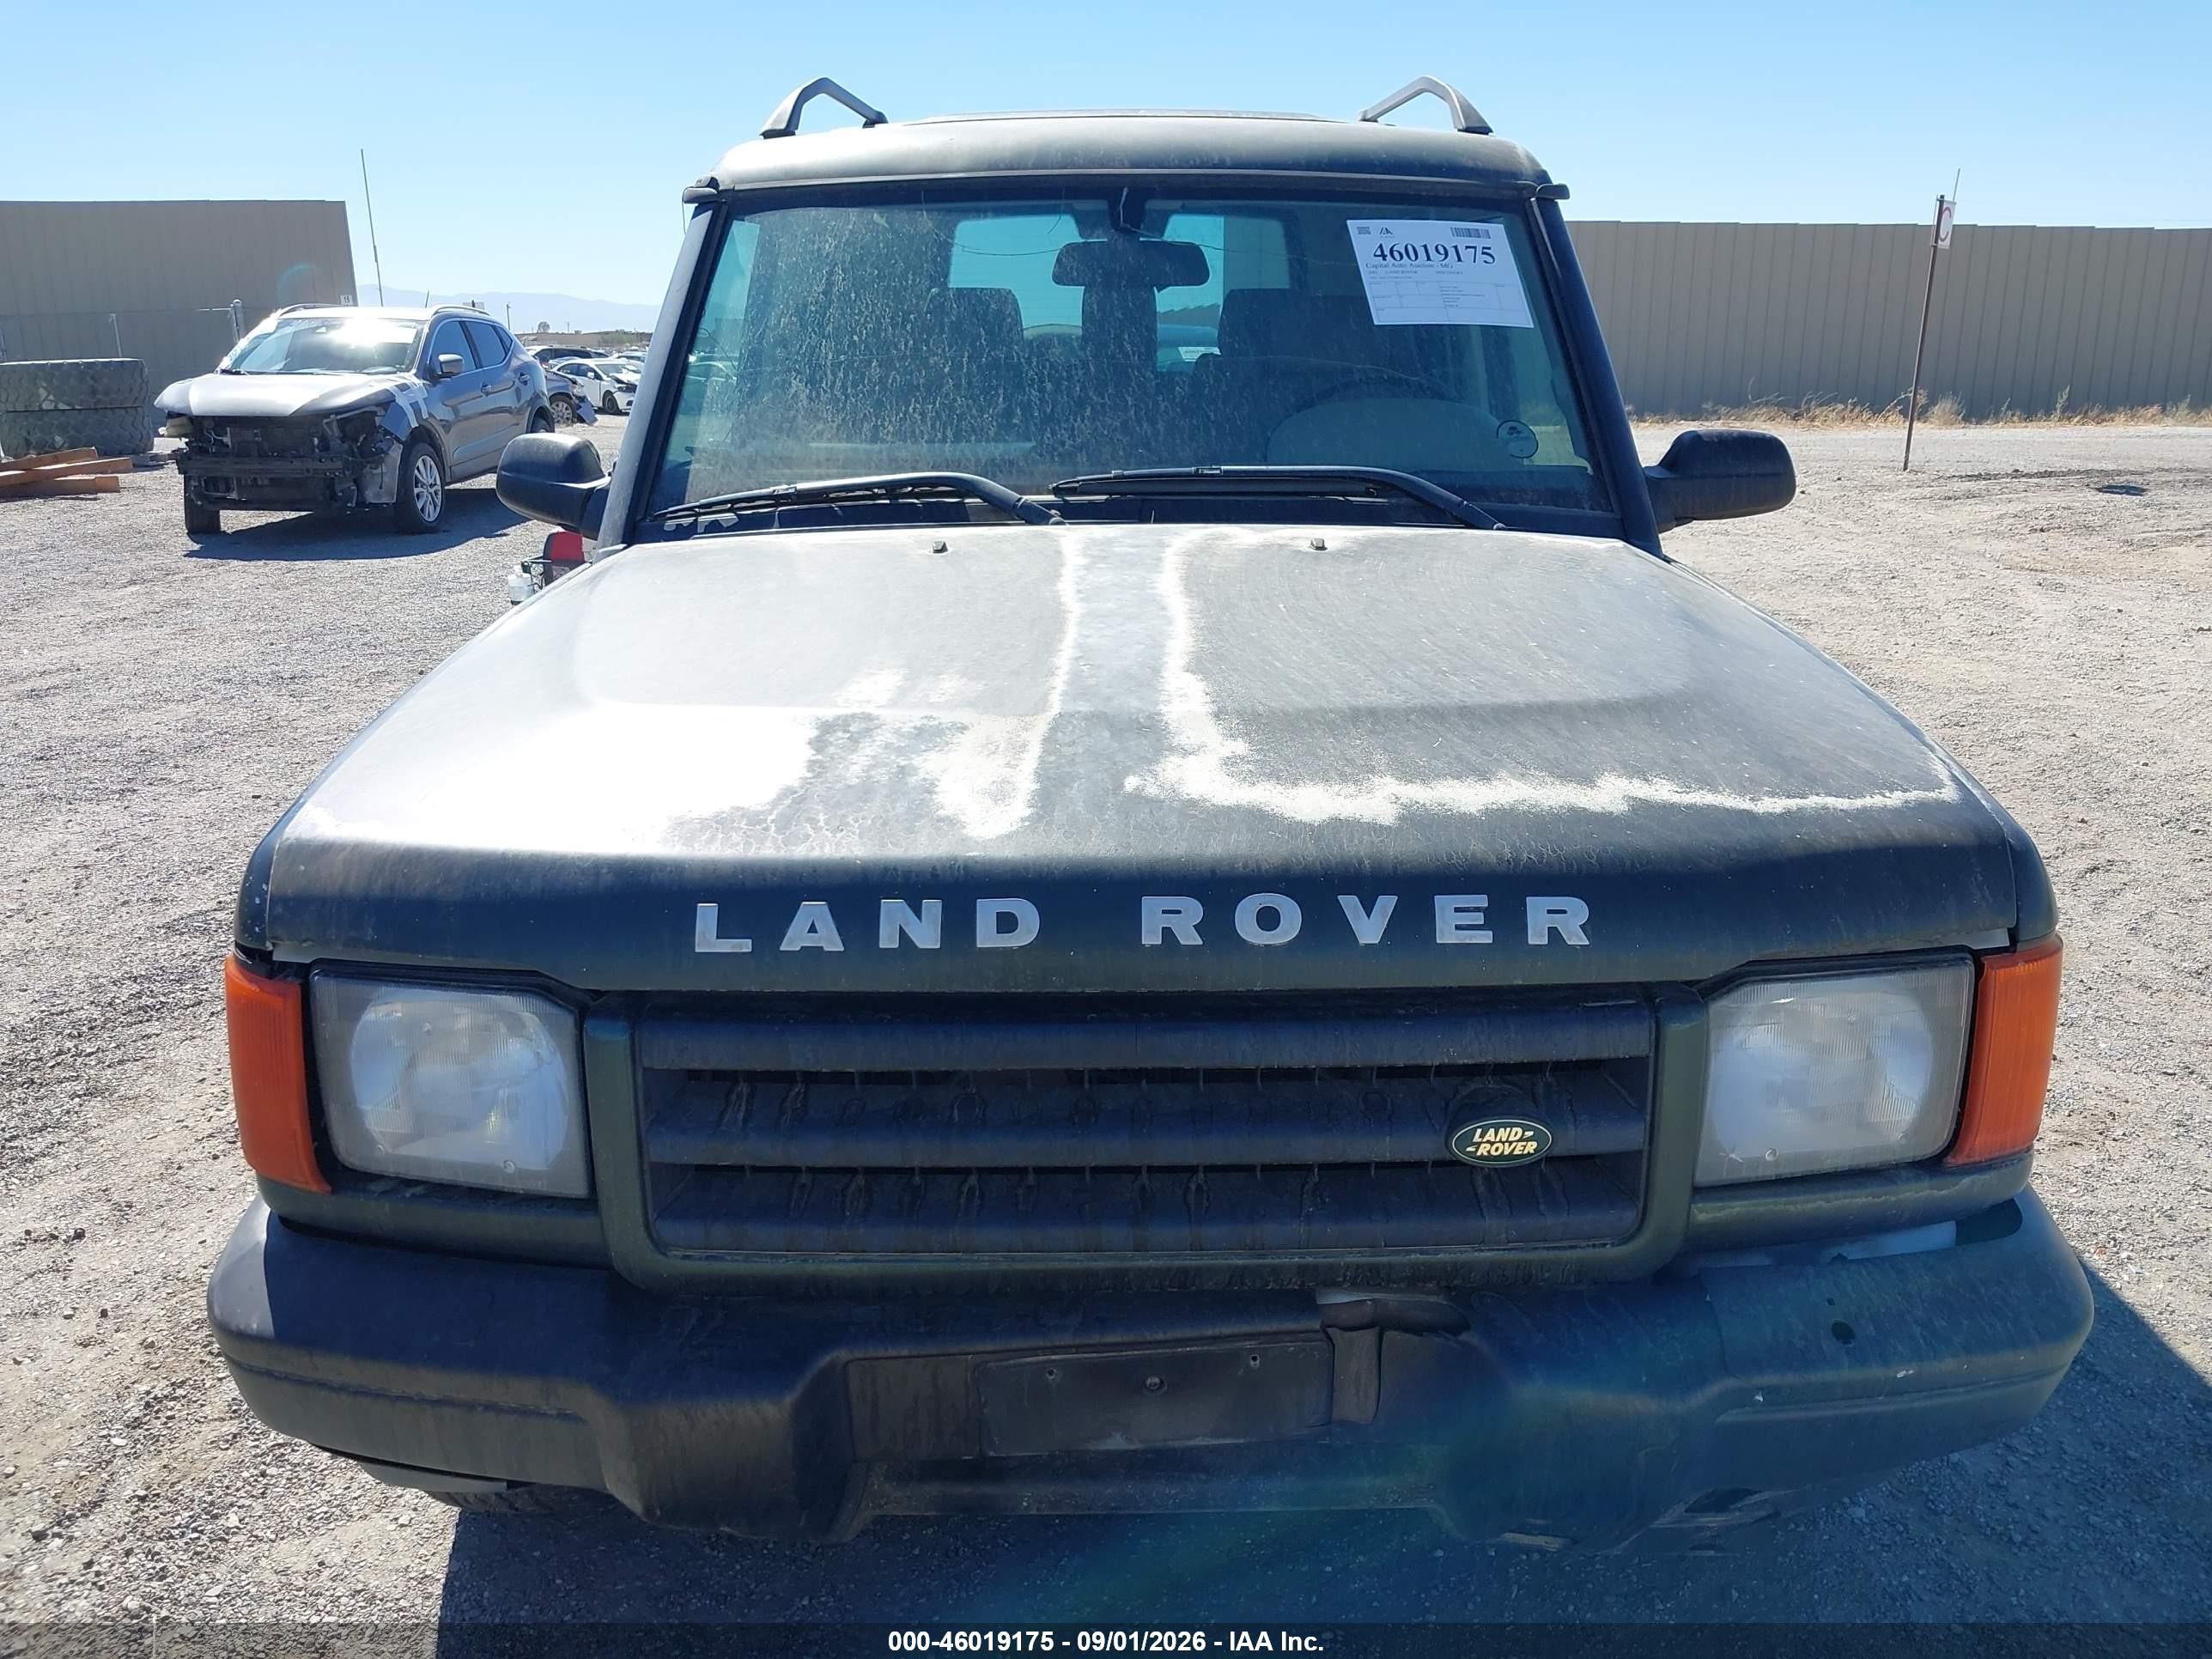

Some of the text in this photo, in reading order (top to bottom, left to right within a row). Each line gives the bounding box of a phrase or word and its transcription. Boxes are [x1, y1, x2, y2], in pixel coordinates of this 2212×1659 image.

[1374, 243, 1496, 264] 46019175
[695, 892, 1590, 953] LAND ROVER
